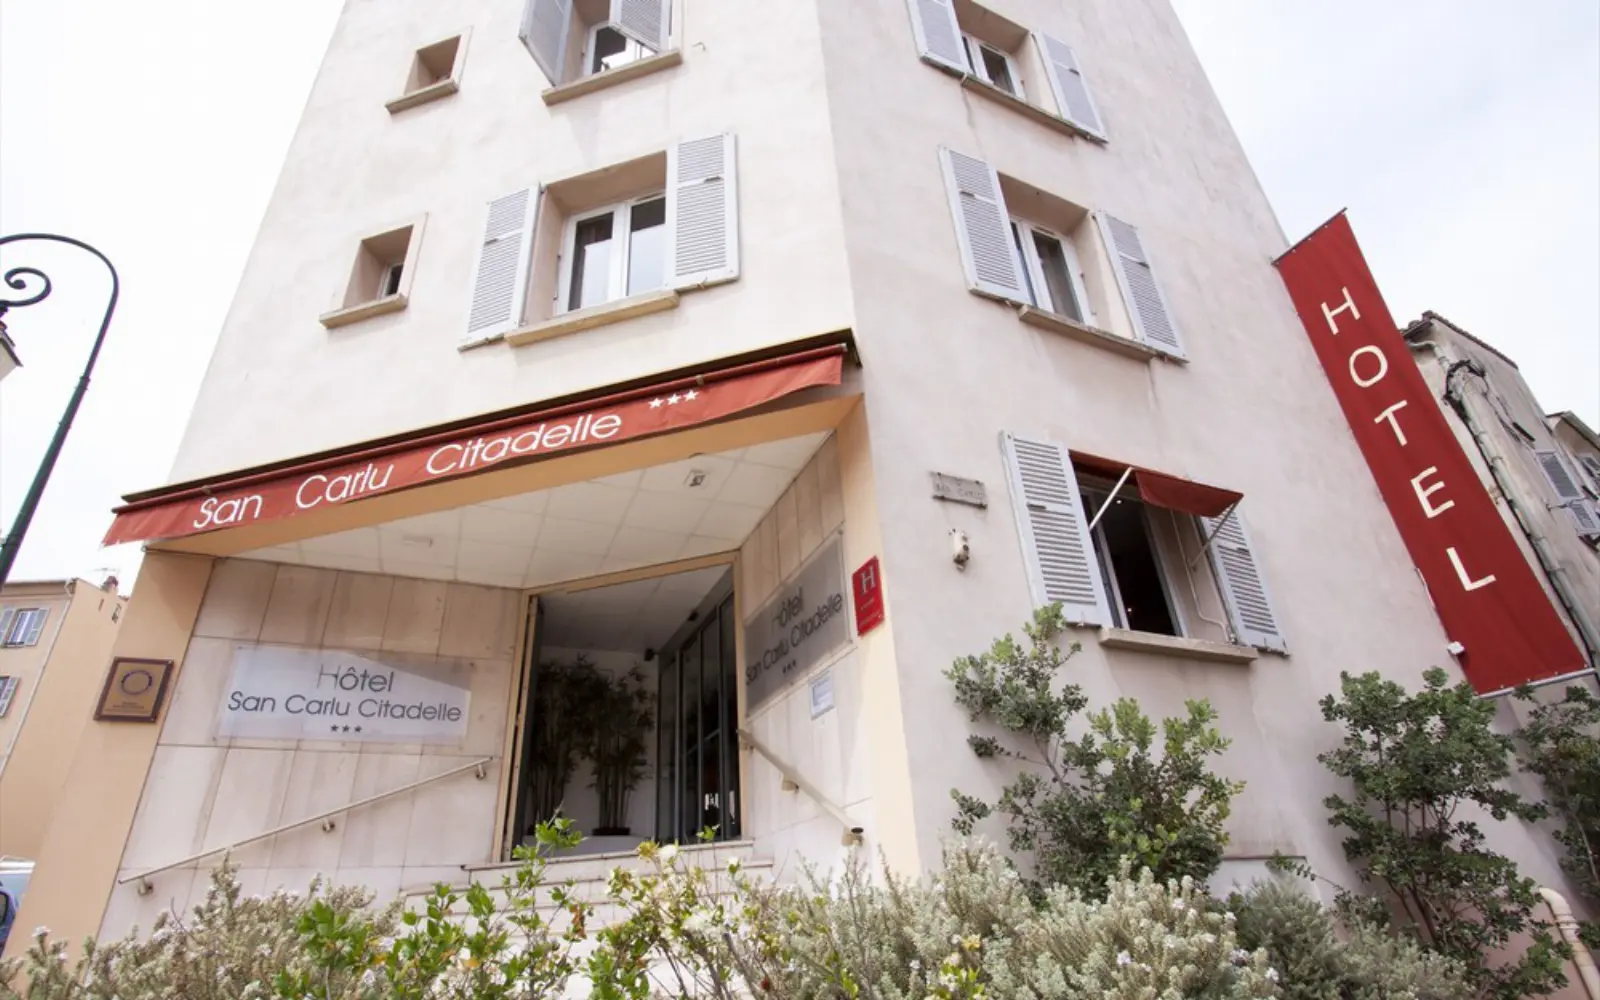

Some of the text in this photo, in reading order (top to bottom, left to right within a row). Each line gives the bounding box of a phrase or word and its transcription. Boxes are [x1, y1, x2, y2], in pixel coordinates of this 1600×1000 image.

[1321, 286, 1497, 592] HOTEL
[193, 413, 622, 529] San Carlu Citadelle
[860, 565, 877, 596] H
[790, 592, 843, 648] Citadelle
[316, 664, 395, 693] Hôtel
[227, 691, 462, 722] San Carlu Citadelle
